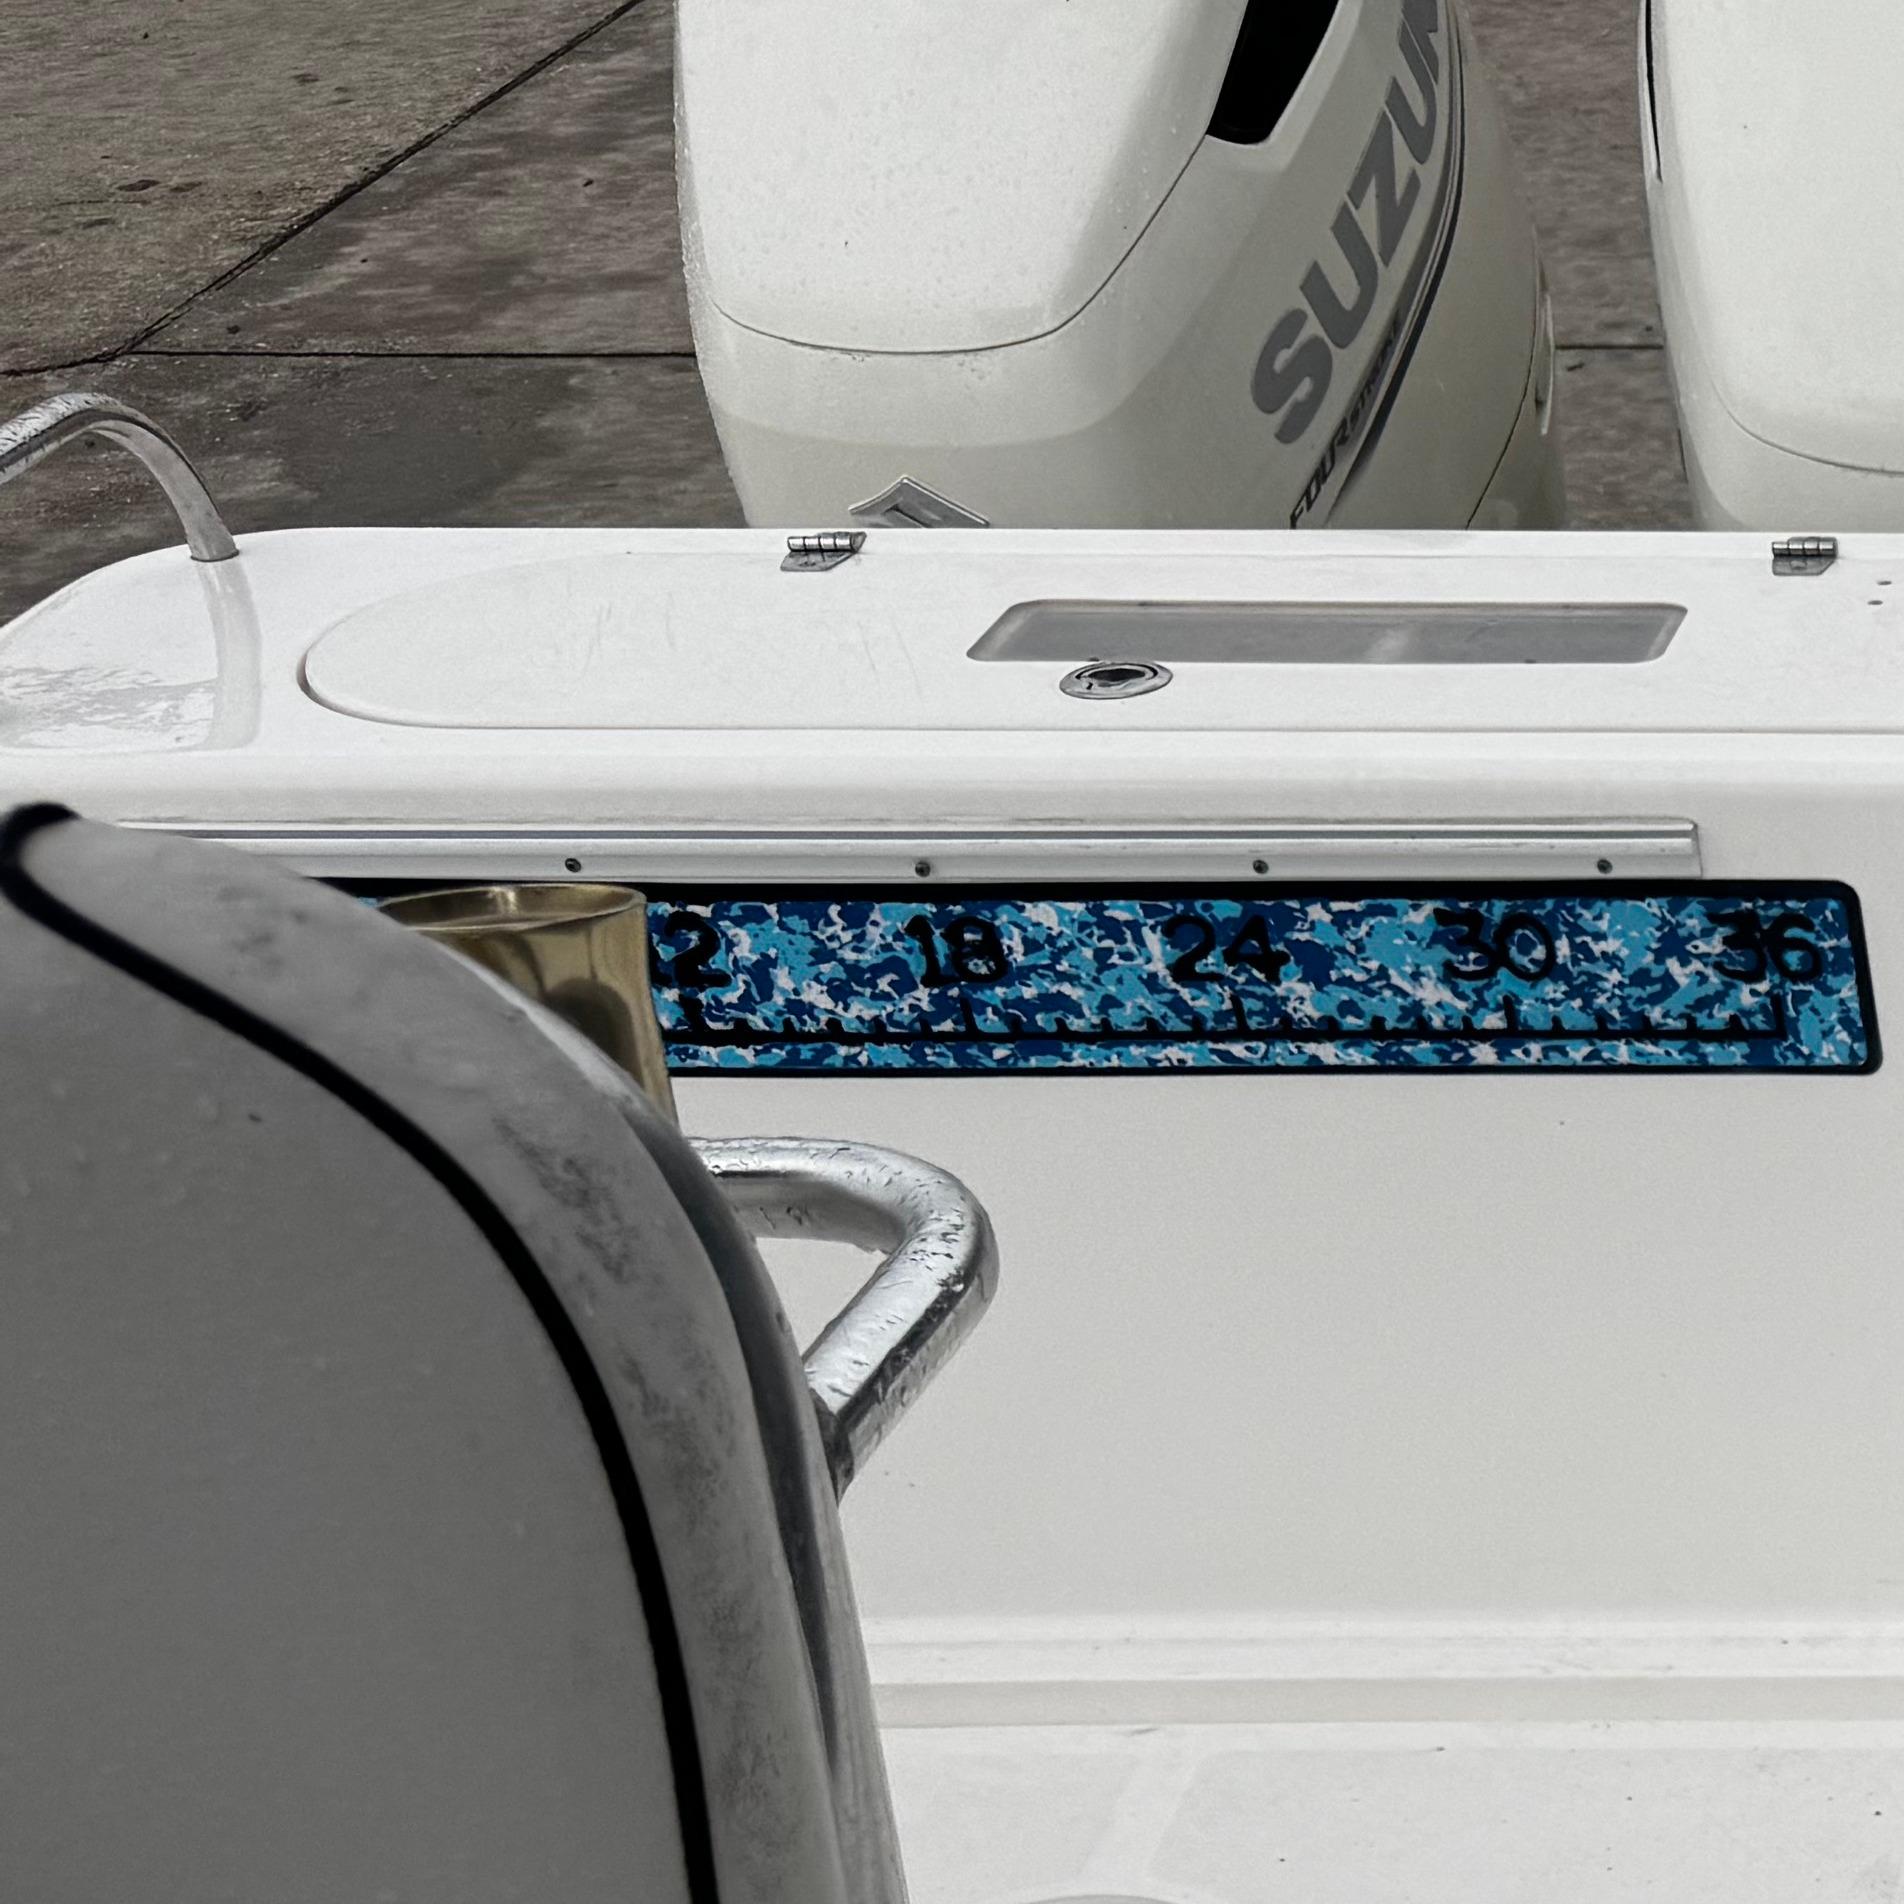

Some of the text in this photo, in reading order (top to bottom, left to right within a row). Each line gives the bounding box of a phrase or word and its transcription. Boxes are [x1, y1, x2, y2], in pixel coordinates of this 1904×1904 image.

[648, 909, 1822, 988] 2 18 24 30 36
